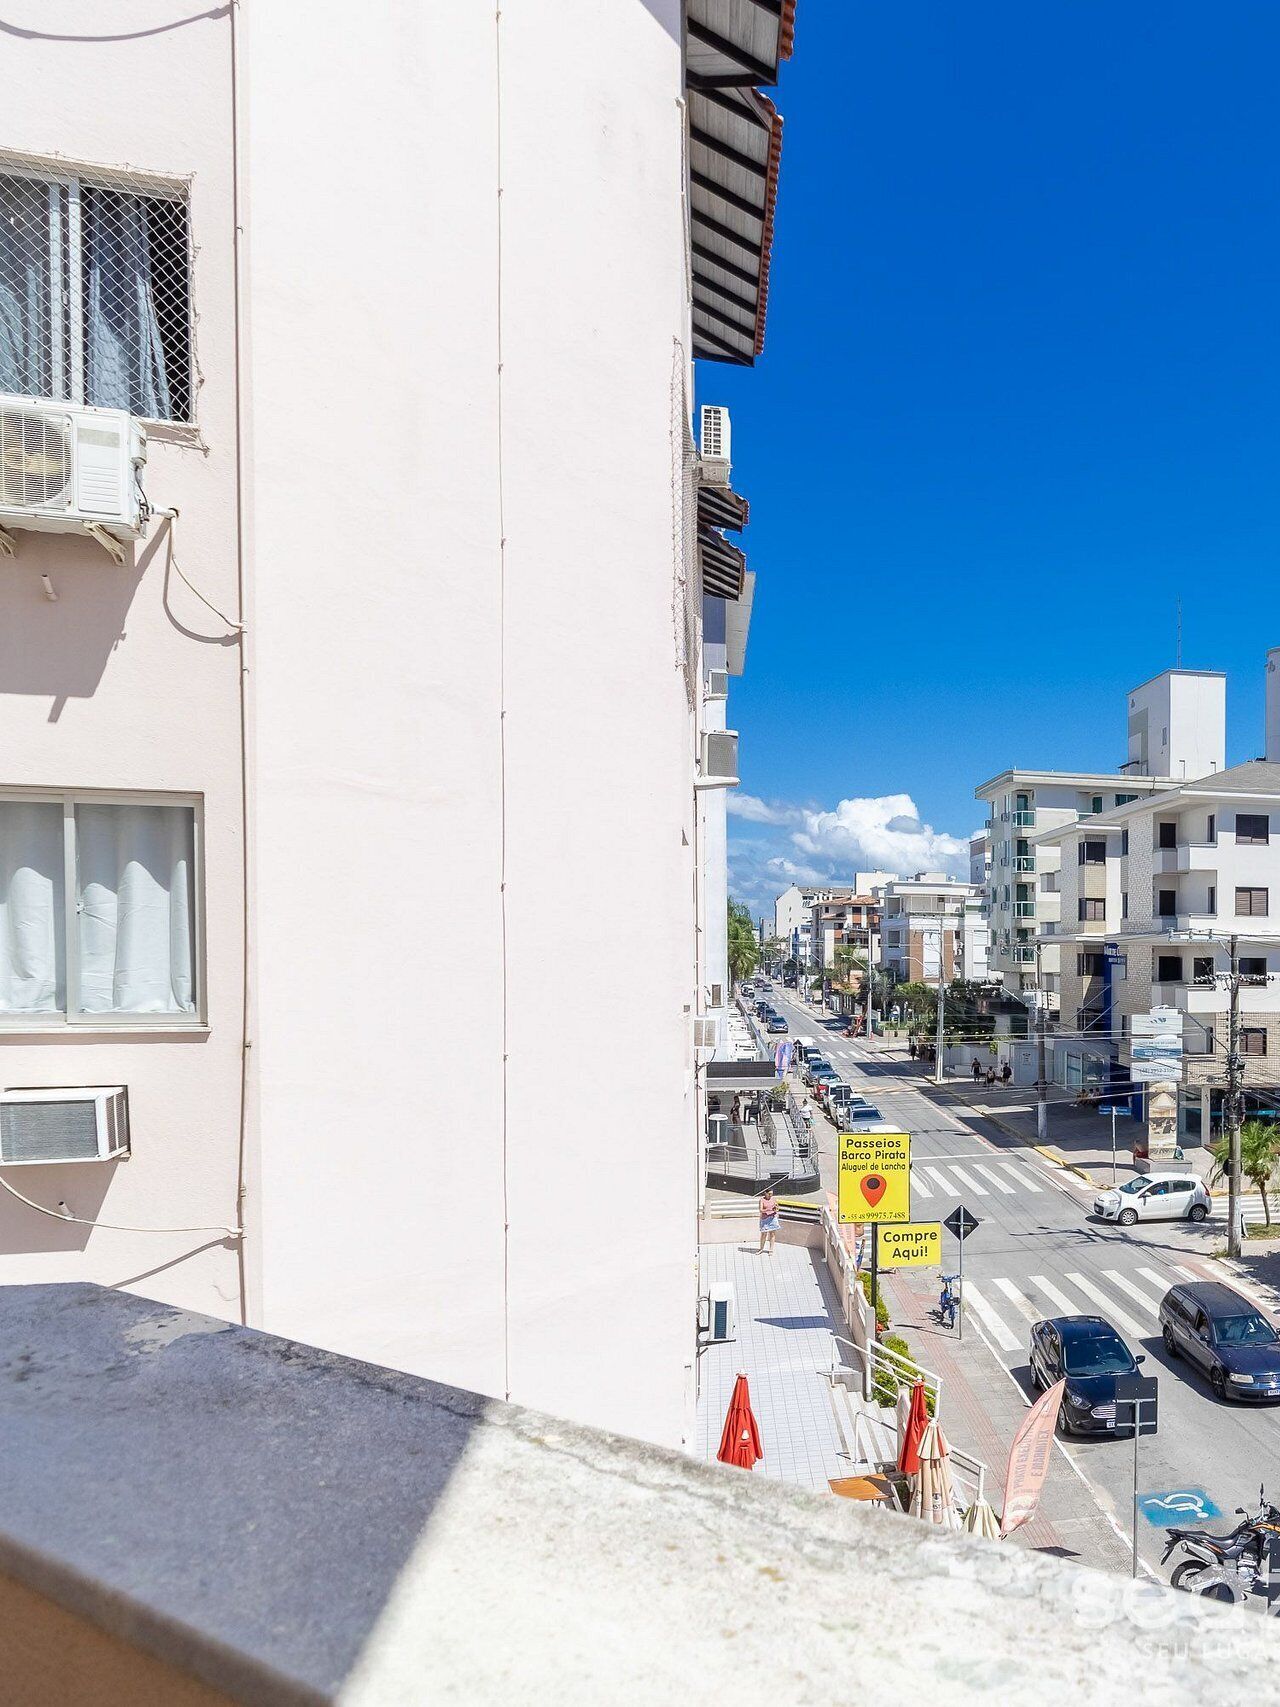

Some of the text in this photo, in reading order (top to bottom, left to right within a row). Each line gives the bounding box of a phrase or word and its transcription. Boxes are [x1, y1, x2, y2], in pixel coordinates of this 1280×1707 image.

[846, 1138, 901, 1148] Passeios
[841, 1150, 906, 1160] Barco Pirata
[841, 1163, 906, 1172] Aluguel de Lancha
[883, 1231, 938, 1244] Compre
[892, 1246, 928, 1260] Aqui!
